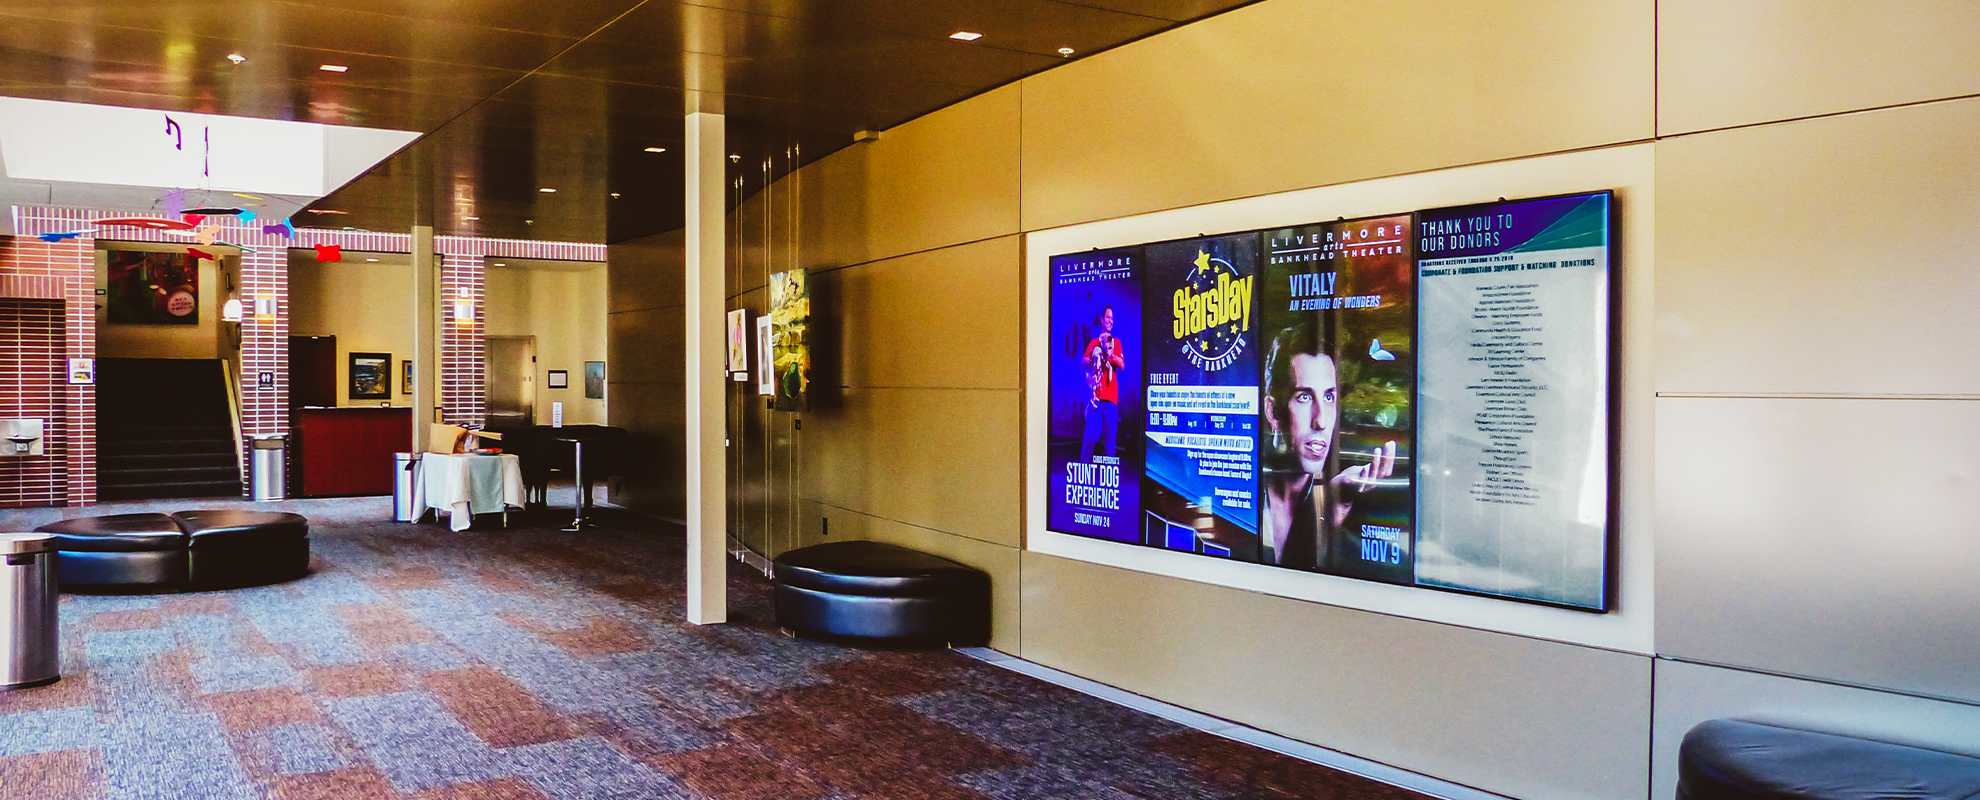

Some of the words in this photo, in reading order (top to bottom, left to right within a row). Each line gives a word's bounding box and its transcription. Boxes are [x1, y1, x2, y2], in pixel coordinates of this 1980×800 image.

[1422, 219, 1461, 236] THANK
[1468, 216, 1491, 232] YOU
[1498, 214, 1512, 230] TO
[1272, 225, 1401, 247] LIVERMORE
[1422, 236, 1444, 252] OUR
[1450, 231, 1500, 250] DONORS
[1271, 252, 1334, 264] BANKHEAD
[1343, 246, 1402, 258] THEATER
[1324, 242, 1344, 251] arts
[1060, 258, 1130, 272] LIVERMORE
[1421, 268, 1451, 277] CORPORATE
[1458, 266, 1491, 274] FOUNDATION
[1494, 264, 1518, 272] SUPPORT
[1527, 262, 1556, 270] MATCHING
[1561, 259, 1595, 268] DONATIONS
[1099, 272, 1130, 280] THEATER
[1289, 272, 1337, 297] VITALY
[1173, 272, 1253, 339] StarsDay
[1289, 300, 1299, 311] AN
[1301, 298, 1330, 310] EVENING
[1333, 297, 1343, 309] OF
[1345, 295, 1381, 308] WONDERS
[1205, 338, 1246, 371] BANKHEAD
[1150, 373, 1162, 384] FREE
[1163, 373, 1179, 384] EVENT
[1067, 462, 1098, 485] STUNT
[1100, 465, 1120, 488] DOG
[1066, 484, 1120, 510] EXPERIENCE
[1075, 512, 1092, 524] SUNDAY
[1093, 515, 1102, 526] NOV
[1103, 516, 1110, 528] 24
[1361, 524, 1401, 541] SATURDAY
[1361, 539, 1388, 562] NOV
[1391, 542, 1400, 564] 9
